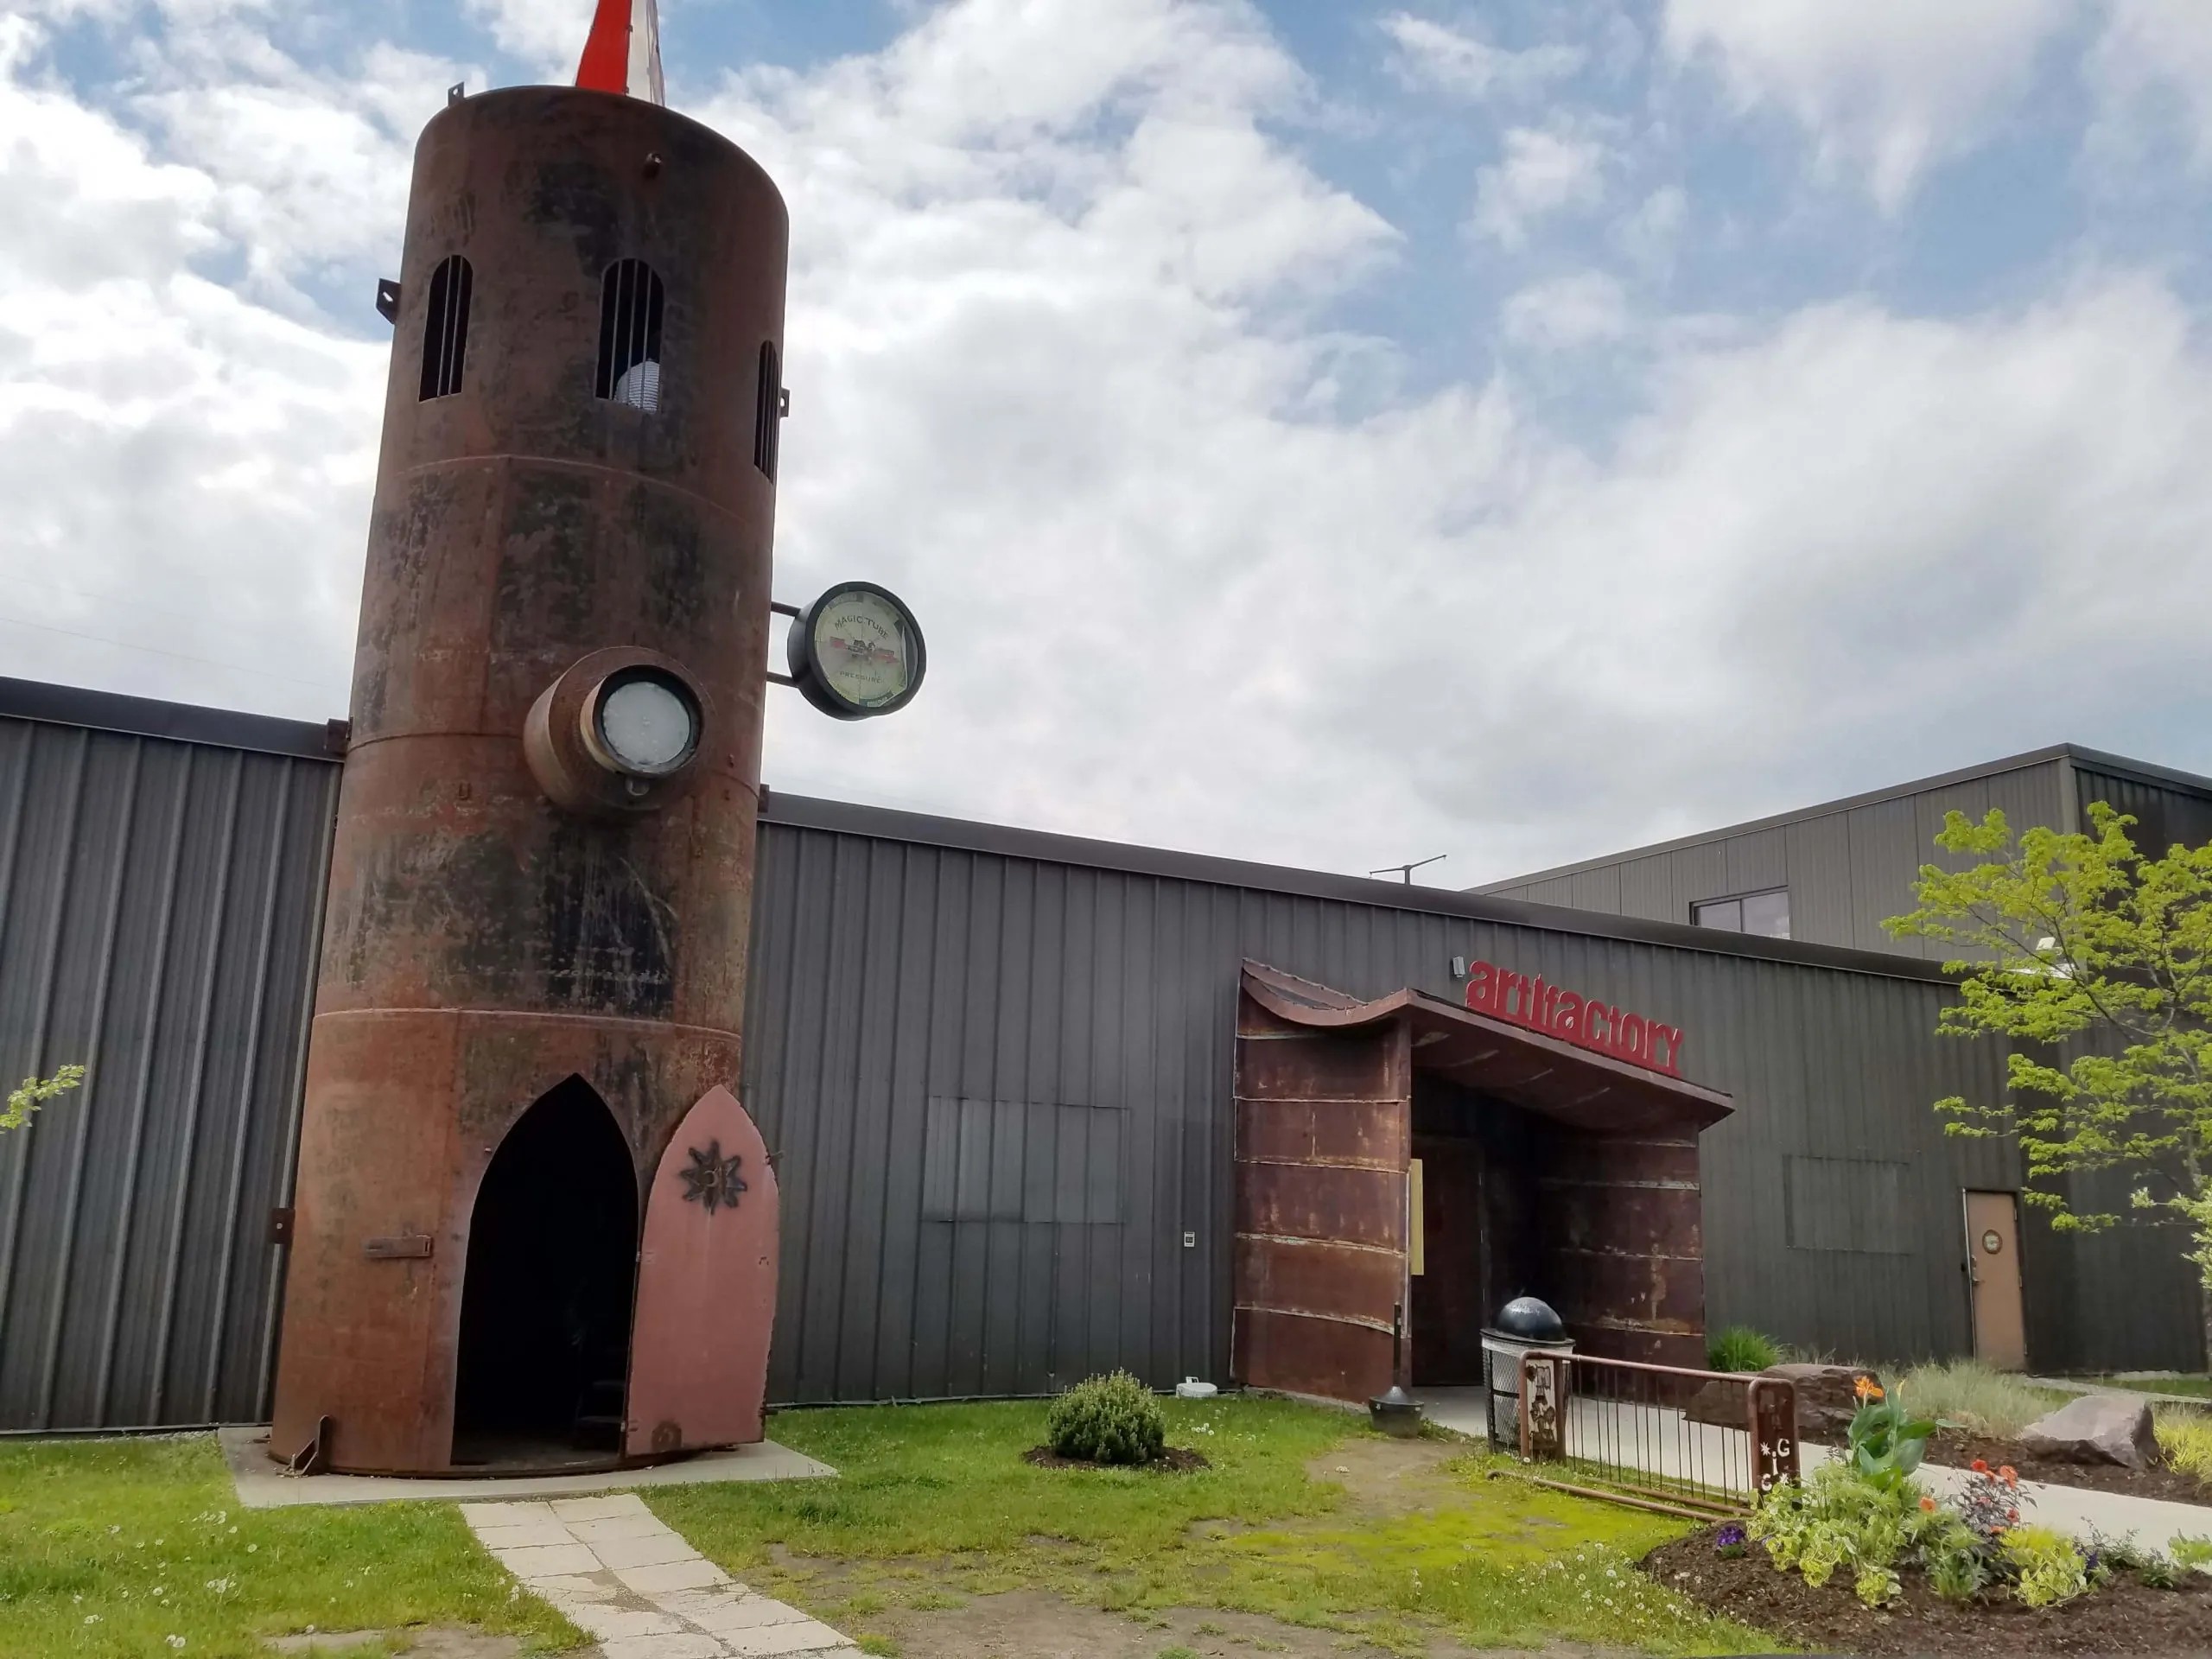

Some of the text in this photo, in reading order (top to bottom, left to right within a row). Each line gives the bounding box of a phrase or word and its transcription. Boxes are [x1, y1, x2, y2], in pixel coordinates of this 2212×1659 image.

[835, 614, 888, 639] MAGIC TUBE
[1465, 960, 1683, 1078] artifactory
